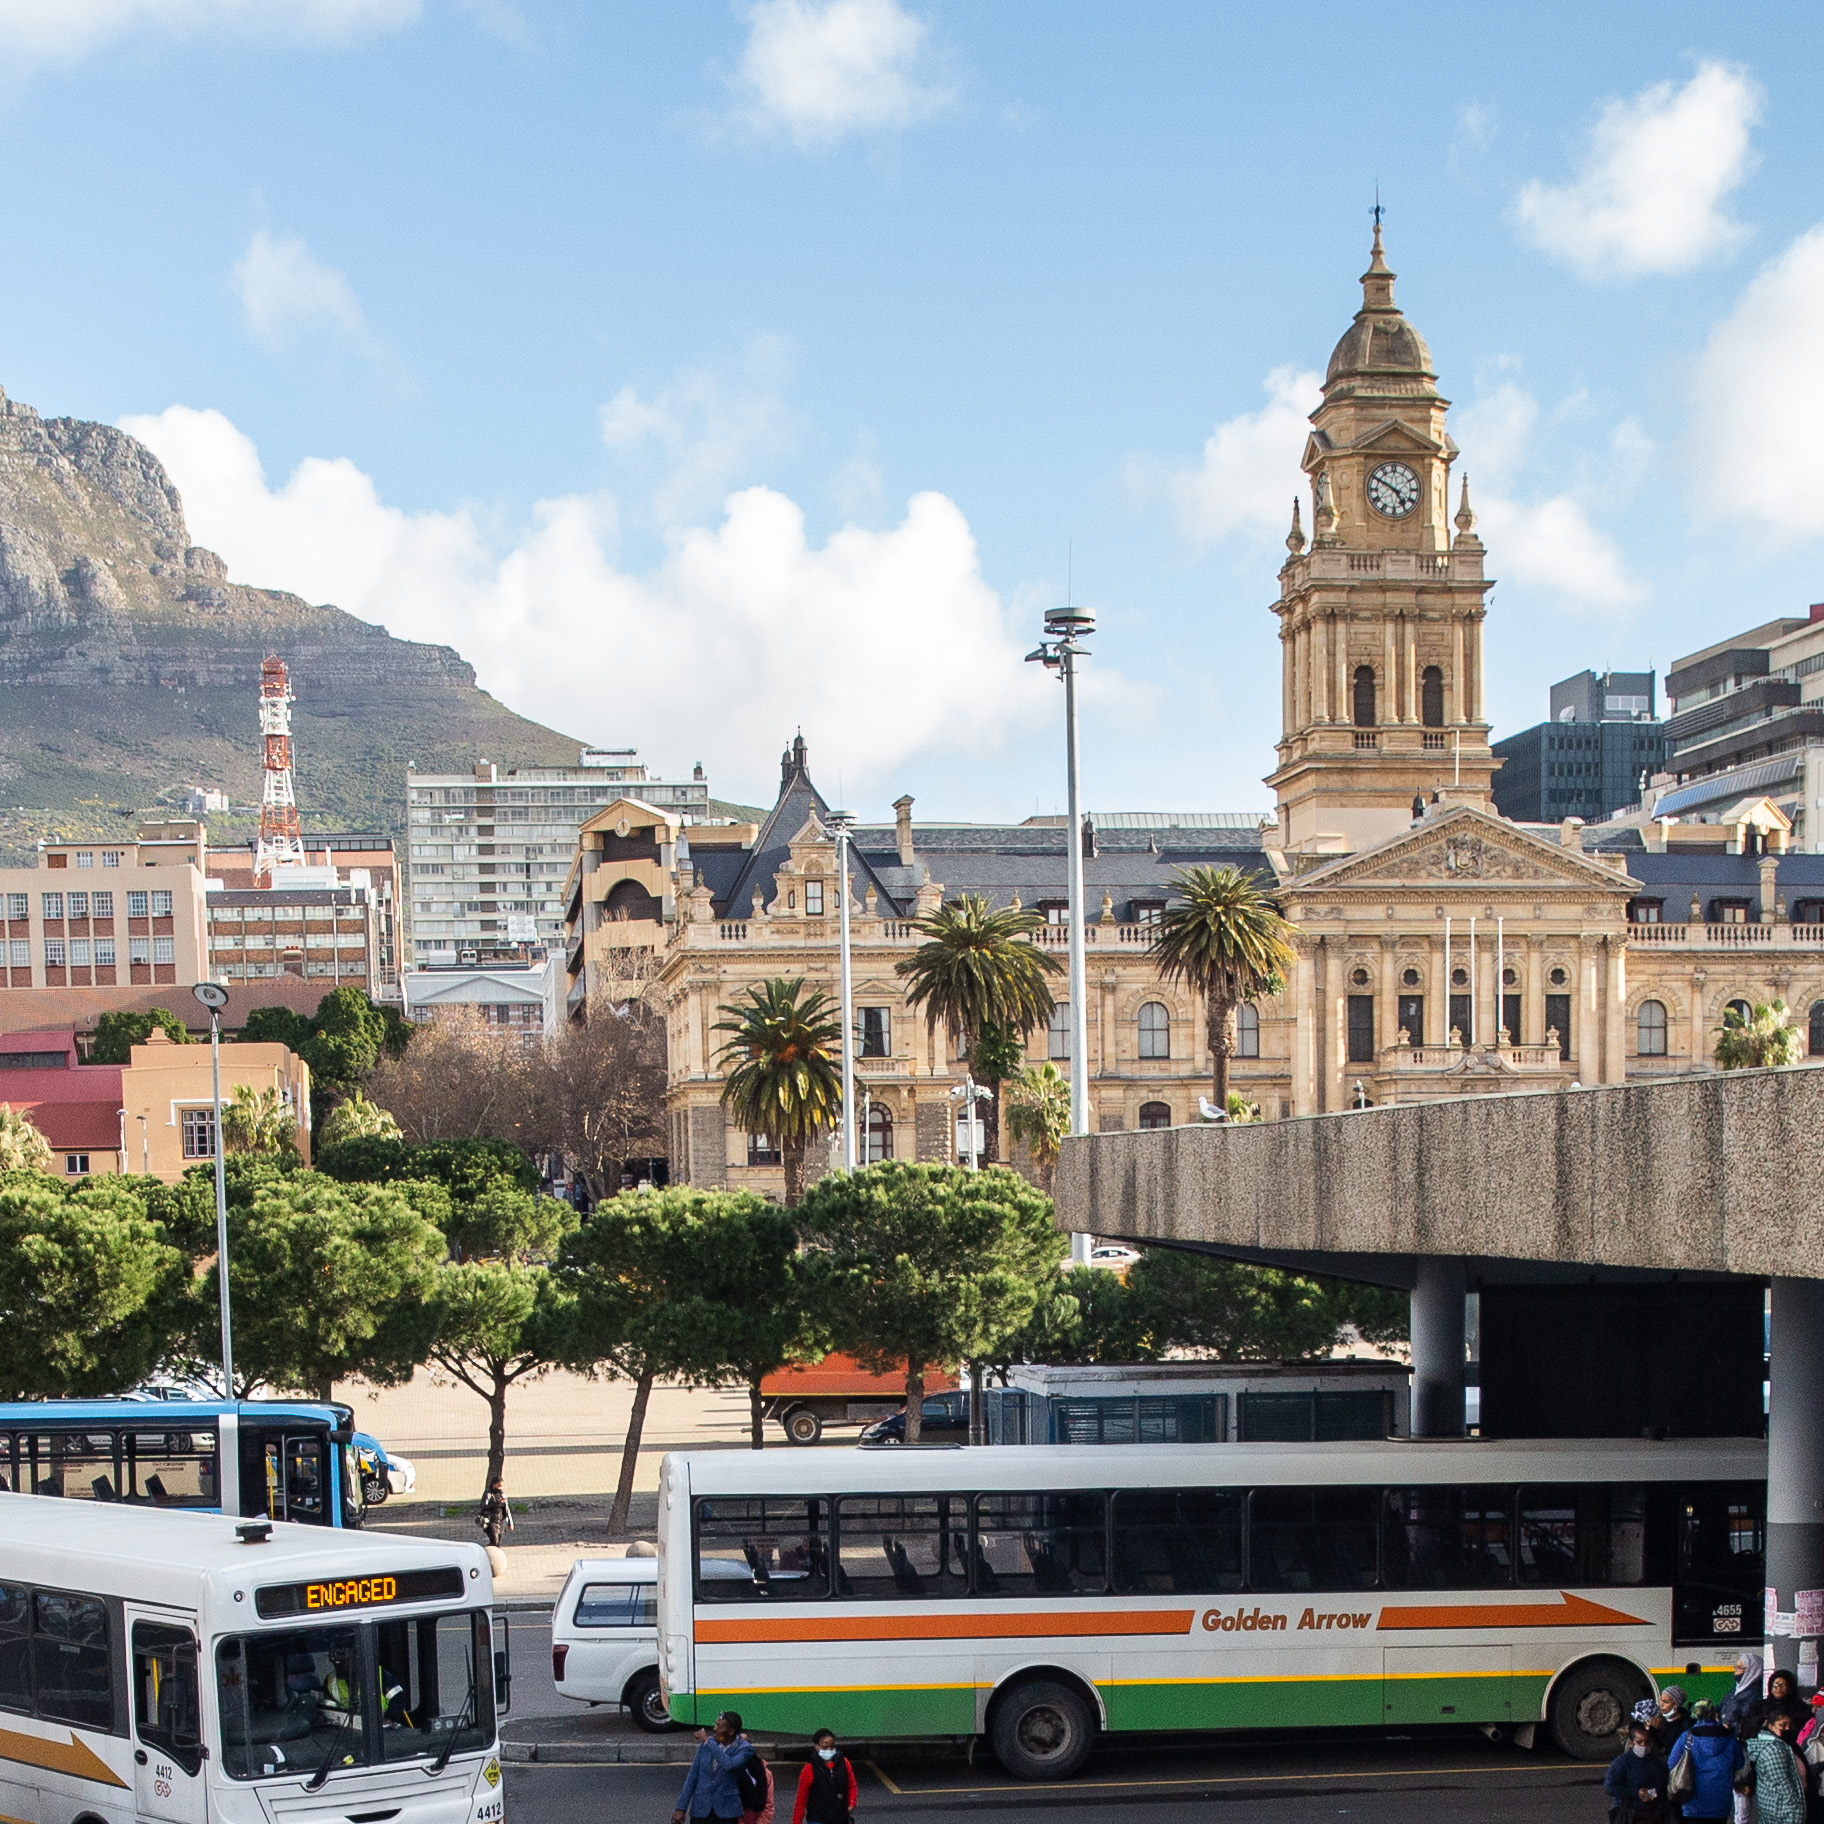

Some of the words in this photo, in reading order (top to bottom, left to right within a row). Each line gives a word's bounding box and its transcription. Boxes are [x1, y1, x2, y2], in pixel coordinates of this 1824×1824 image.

[306, 1577, 396, 1608] ENGAGED
[1202, 1607, 1288, 1632] Golden
[1296, 1607, 1372, 1631] Arrow
[155, 1764, 173, 1781] 4412
[476, 1801, 502, 1821] 4412
